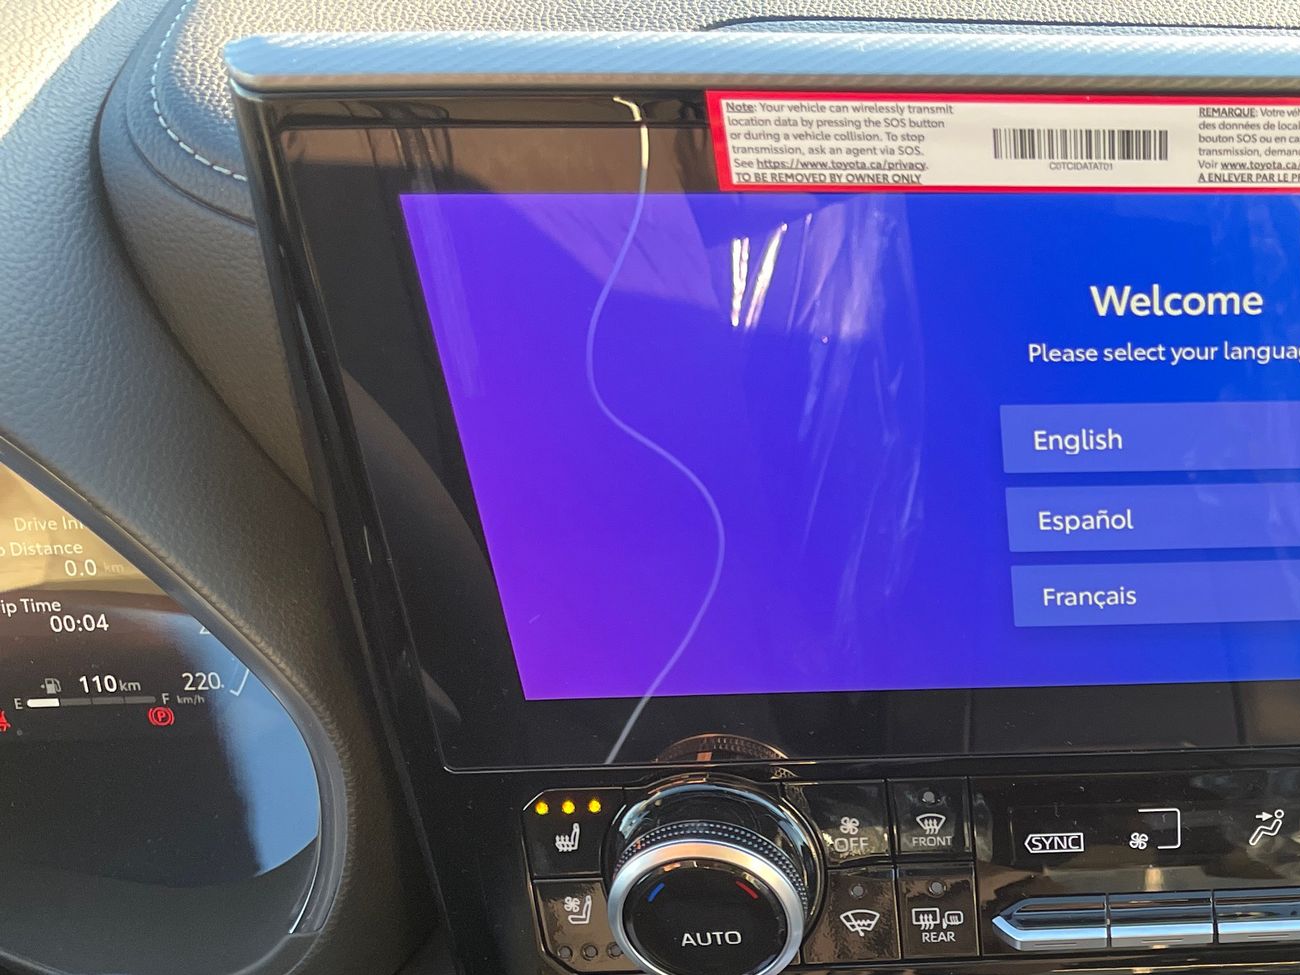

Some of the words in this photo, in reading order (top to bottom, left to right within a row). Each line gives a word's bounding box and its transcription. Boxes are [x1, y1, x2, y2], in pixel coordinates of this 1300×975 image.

[725, 102, 756, 113] Note:
[759, 102, 784, 112] Your
[787, 102, 826, 112] vehicle
[828, 105, 848, 113] can
[851, 103, 904, 114] wirelessly
[907, 105, 953, 114] transmit
[1199, 107, 1257, 118] REMARQUE:
[1260, 108, 1284, 117] Votre
[727, 116, 771, 126] location
[773, 116, 798, 126] data
[800, 117, 813, 129] by
[816, 119, 861, 129] pressing
[863, 117, 881, 127] the
[883, 117, 906, 127] SOS
[908, 119, 944, 128] button
[1198, 120, 1216, 130] des
[1218, 121, 1260, 130] données
[1262, 121, 1275, 130] de
[808, 145, 826, 154] ask
[845, 146, 877, 157] agent
[879, 145, 895, 155] via
[734, 158, 753, 167] See
[1198, 160, 1217, 169] Voir
[736, 173, 751, 183] TO
[755, 173, 768, 183] BE
[771, 173, 827, 183] REMOVED
[829, 173, 842, 183] BY
[846, 174, 889, 184] OWNER
[893, 174, 920, 184] ONLY
[1207, 173, 1254, 183] ENLEVER
[1255, 173, 1276, 182] PAR
[1277, 173, 1290, 182] LE
[1090, 284, 1263, 316] Welcome
[1028, 344, 1098, 362] Please
[1104, 342, 1164, 362] select
[1170, 345, 1218, 365] your
[1034, 428, 1122, 454] English
[14, 517, 58, 532] Drive
[1038, 509, 1134, 533] Español
[11, 542, 83, 557] Distance
[65, 560, 96, 576] 0.0
[1043, 586, 1136, 608] Français
[0, 601, 16, 617] ip
[20, 599, 61, 612] Time
[50, 614, 109, 632] 00:04
[80, 675, 117, 692] 110
[120, 680, 141, 691] km
[182, 672, 221, 690] 220
[15, 698, 23, 709] E
[162, 693, 170, 704] F
[834, 838, 868, 852] OFF
[912, 836, 952, 847] FRONT
[1031, 836, 1081, 851] SYNC
[682, 930, 742, 947] AUTO
[921, 930, 956, 943] REAR
